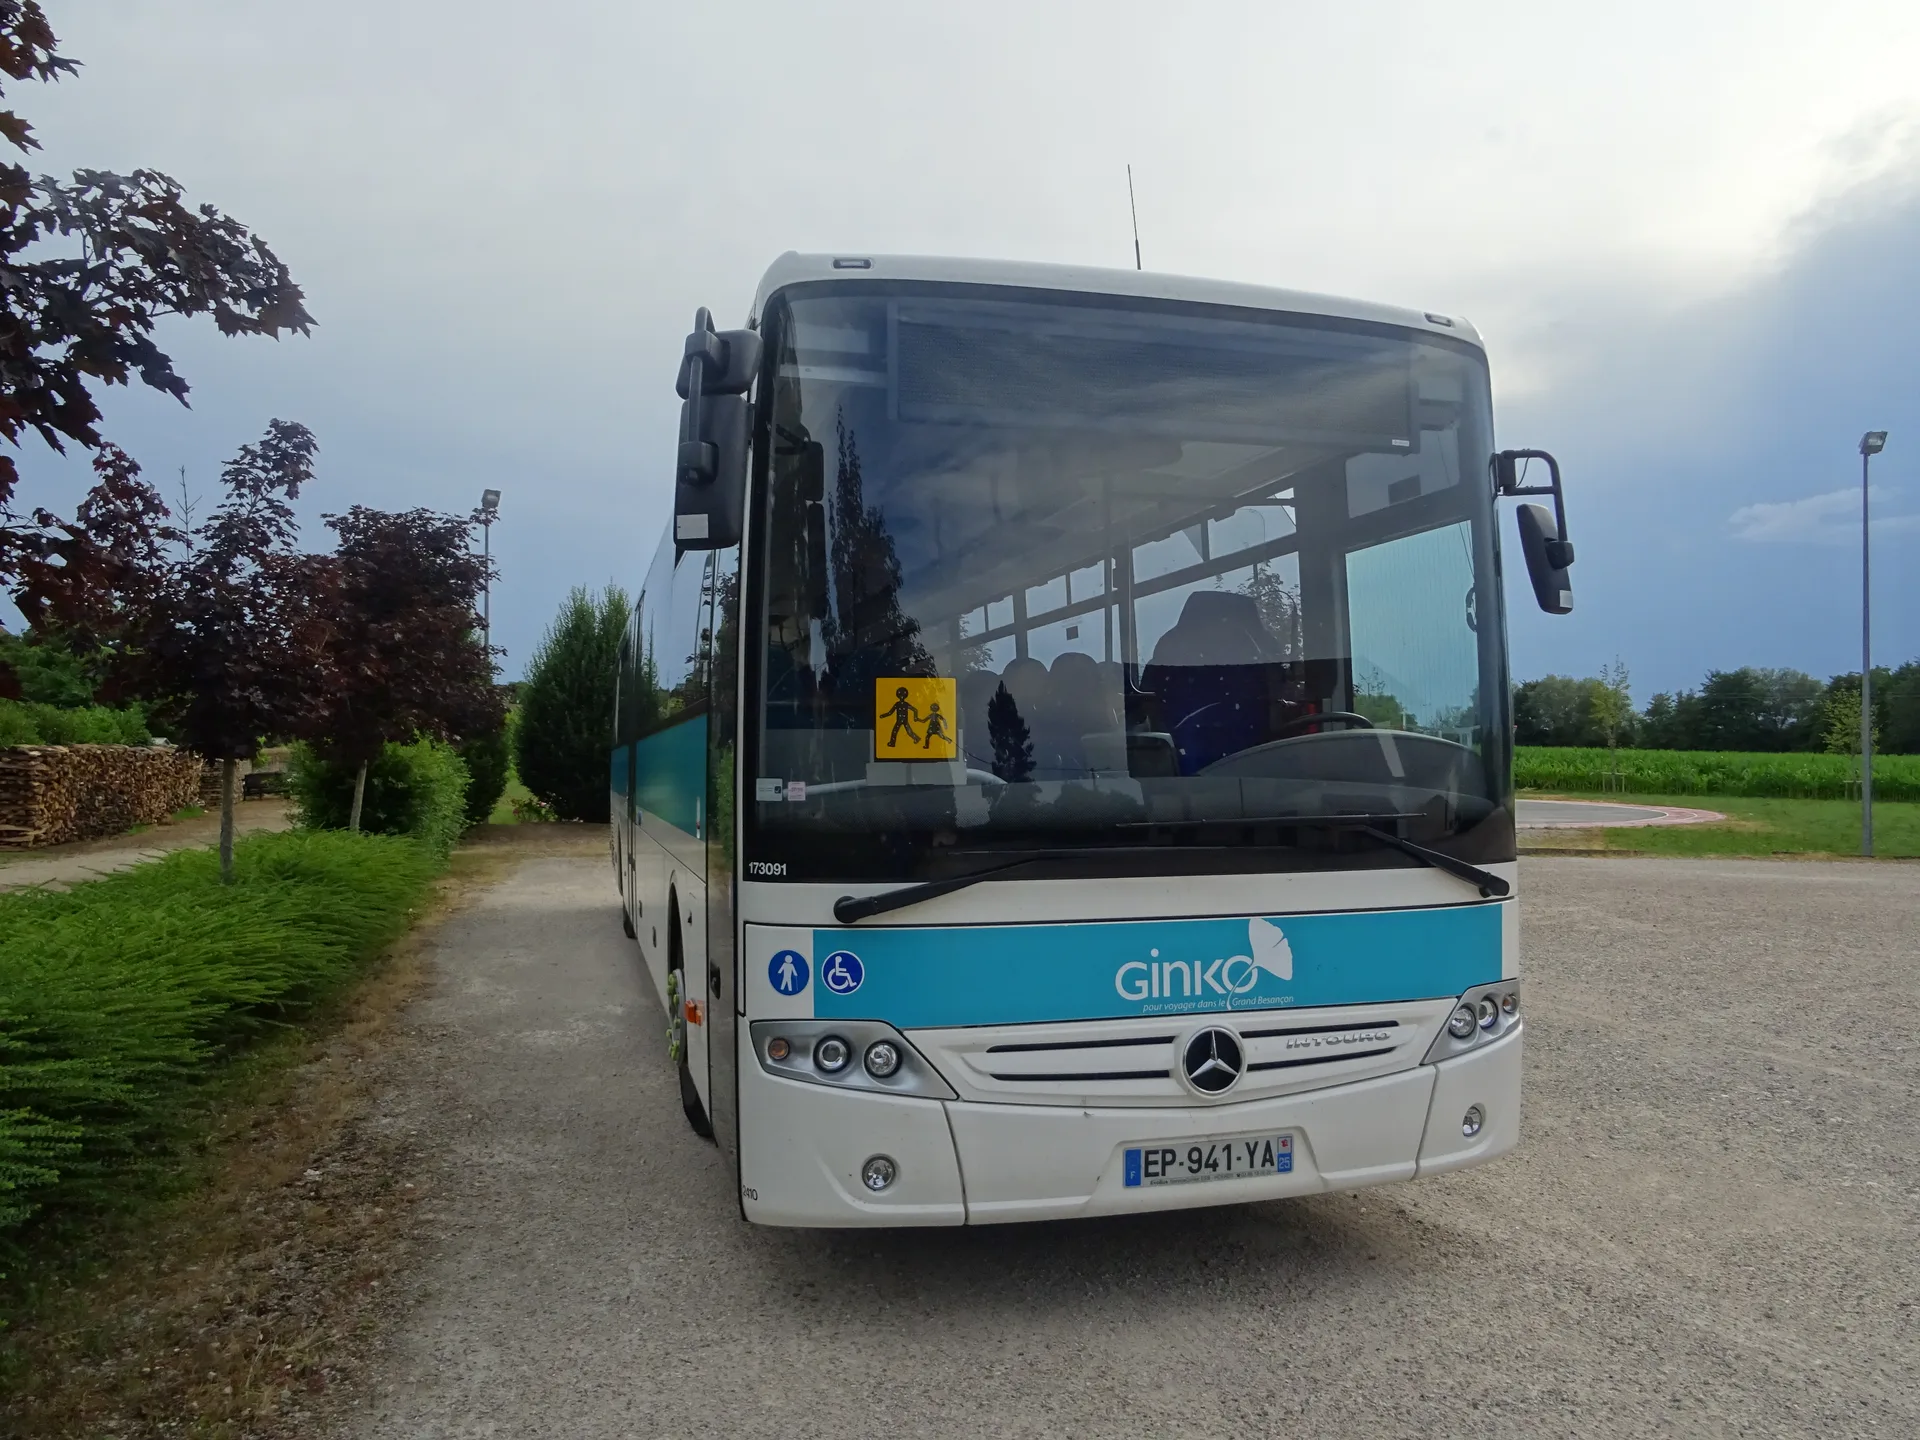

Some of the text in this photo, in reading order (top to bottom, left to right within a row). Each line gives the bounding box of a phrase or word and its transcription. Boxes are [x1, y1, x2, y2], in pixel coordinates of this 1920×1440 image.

[748, 861, 787, 876] 173091
[1142, 995, 1294, 1014] pour voyager dans le Grand Besançon
[1285, 1031, 1392, 1049] INTOURO
[1278, 1156, 1291, 1170] 25
